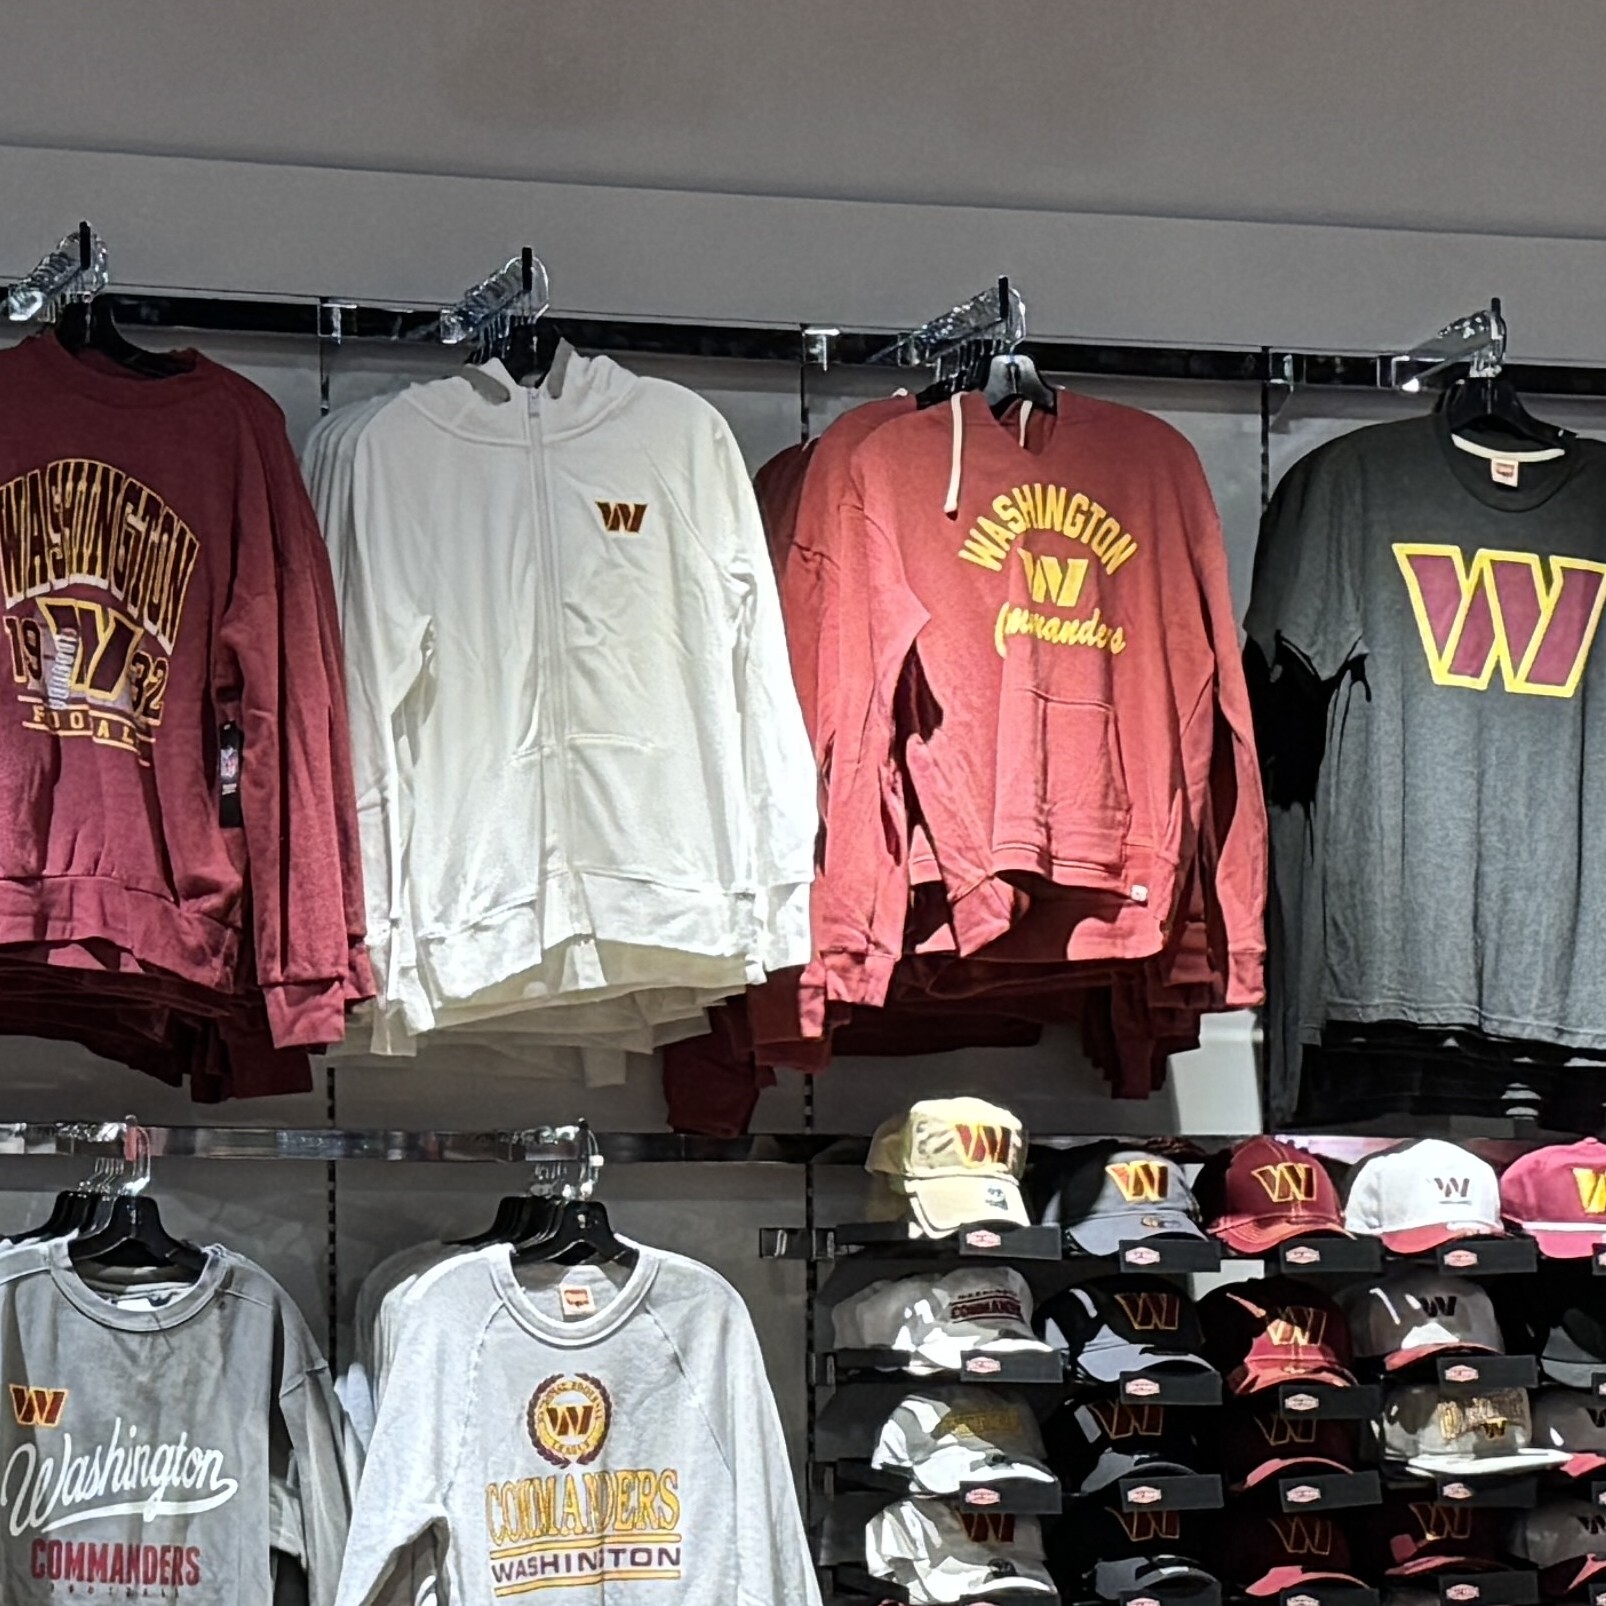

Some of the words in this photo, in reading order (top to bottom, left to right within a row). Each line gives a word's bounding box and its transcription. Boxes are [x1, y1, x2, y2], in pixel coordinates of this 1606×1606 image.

[595, 501, 648, 534] W
[958, 483, 1137, 575] WASHINGTON
[1251, 1163, 1316, 1202] W
[9, 1384, 68, 1427] W
[0, 1417, 238, 1537] Washington
[486, 1468, 679, 1545] COMMANDERS
[31, 1538, 201, 1586] COMMANDERS
[491, 1547, 681, 1583] WASHINTON
